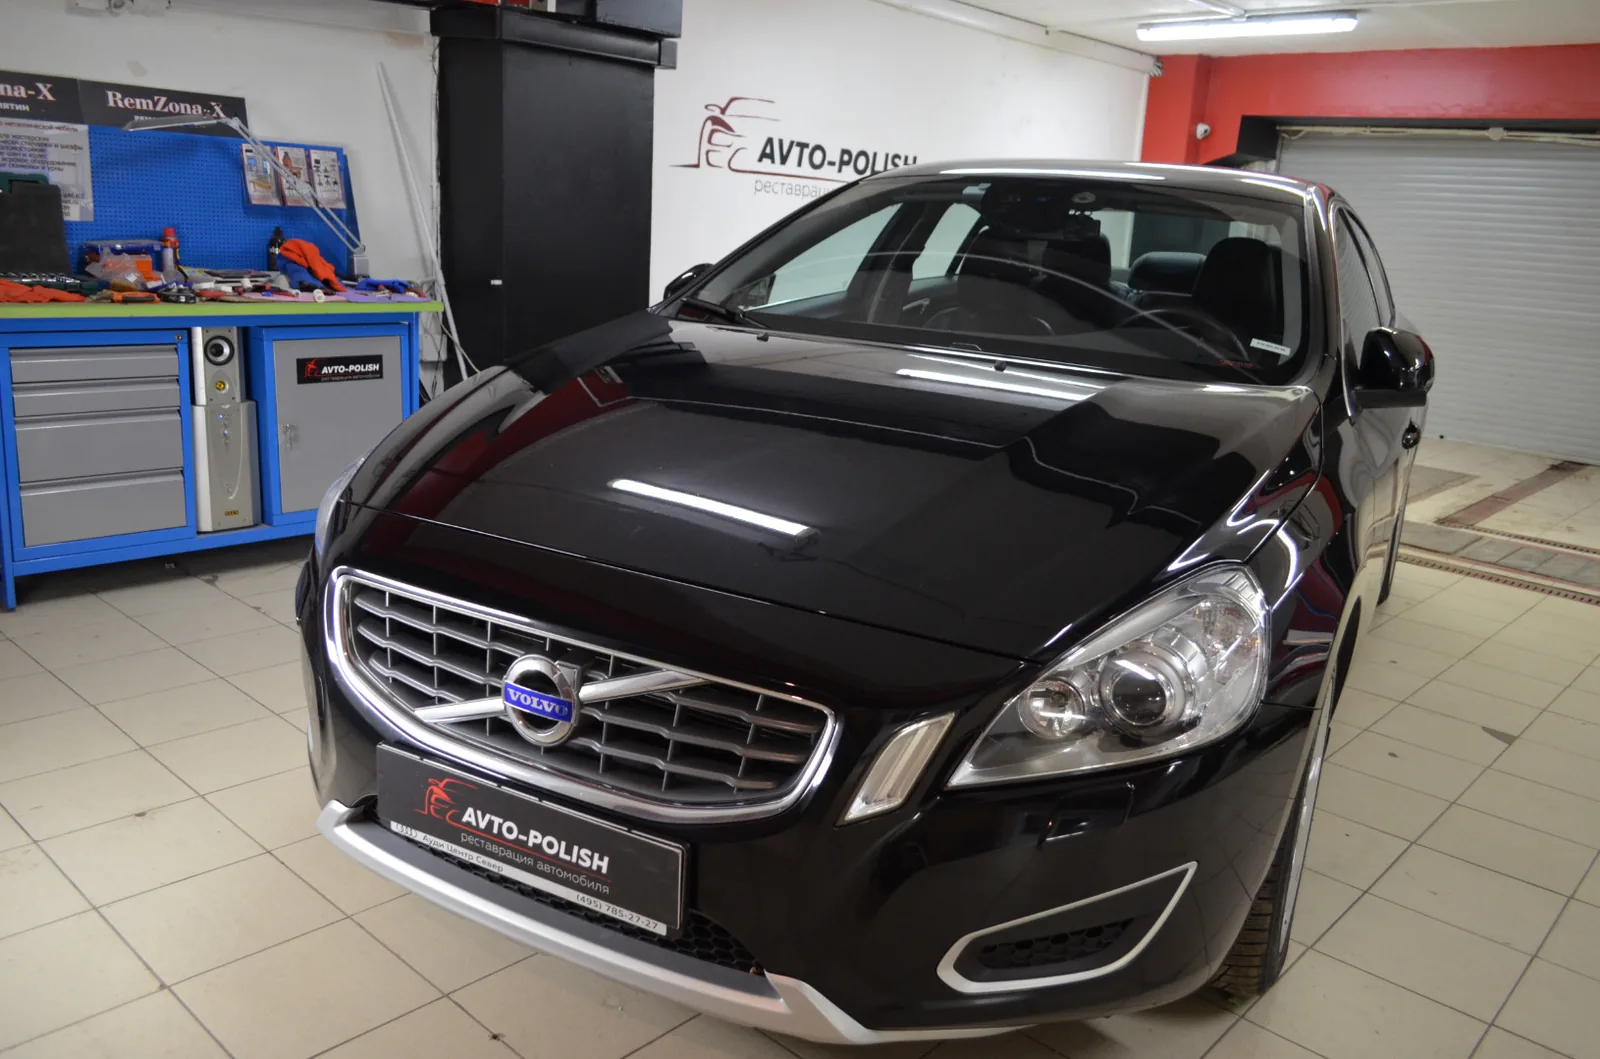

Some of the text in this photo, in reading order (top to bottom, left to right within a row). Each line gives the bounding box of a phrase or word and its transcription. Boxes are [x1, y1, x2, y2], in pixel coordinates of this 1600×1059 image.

[321, 363, 380, 374] AVTO-POLISH
[507, 687, 569, 716] VOLVO
[422, 834, 504, 873] Ауди Центр Север
[461, 806, 610, 874] AVTO-POLISH
[460, 832, 610, 895] реставрация автомобиля
[576, 892, 658, 930] (495) 785-27-27
